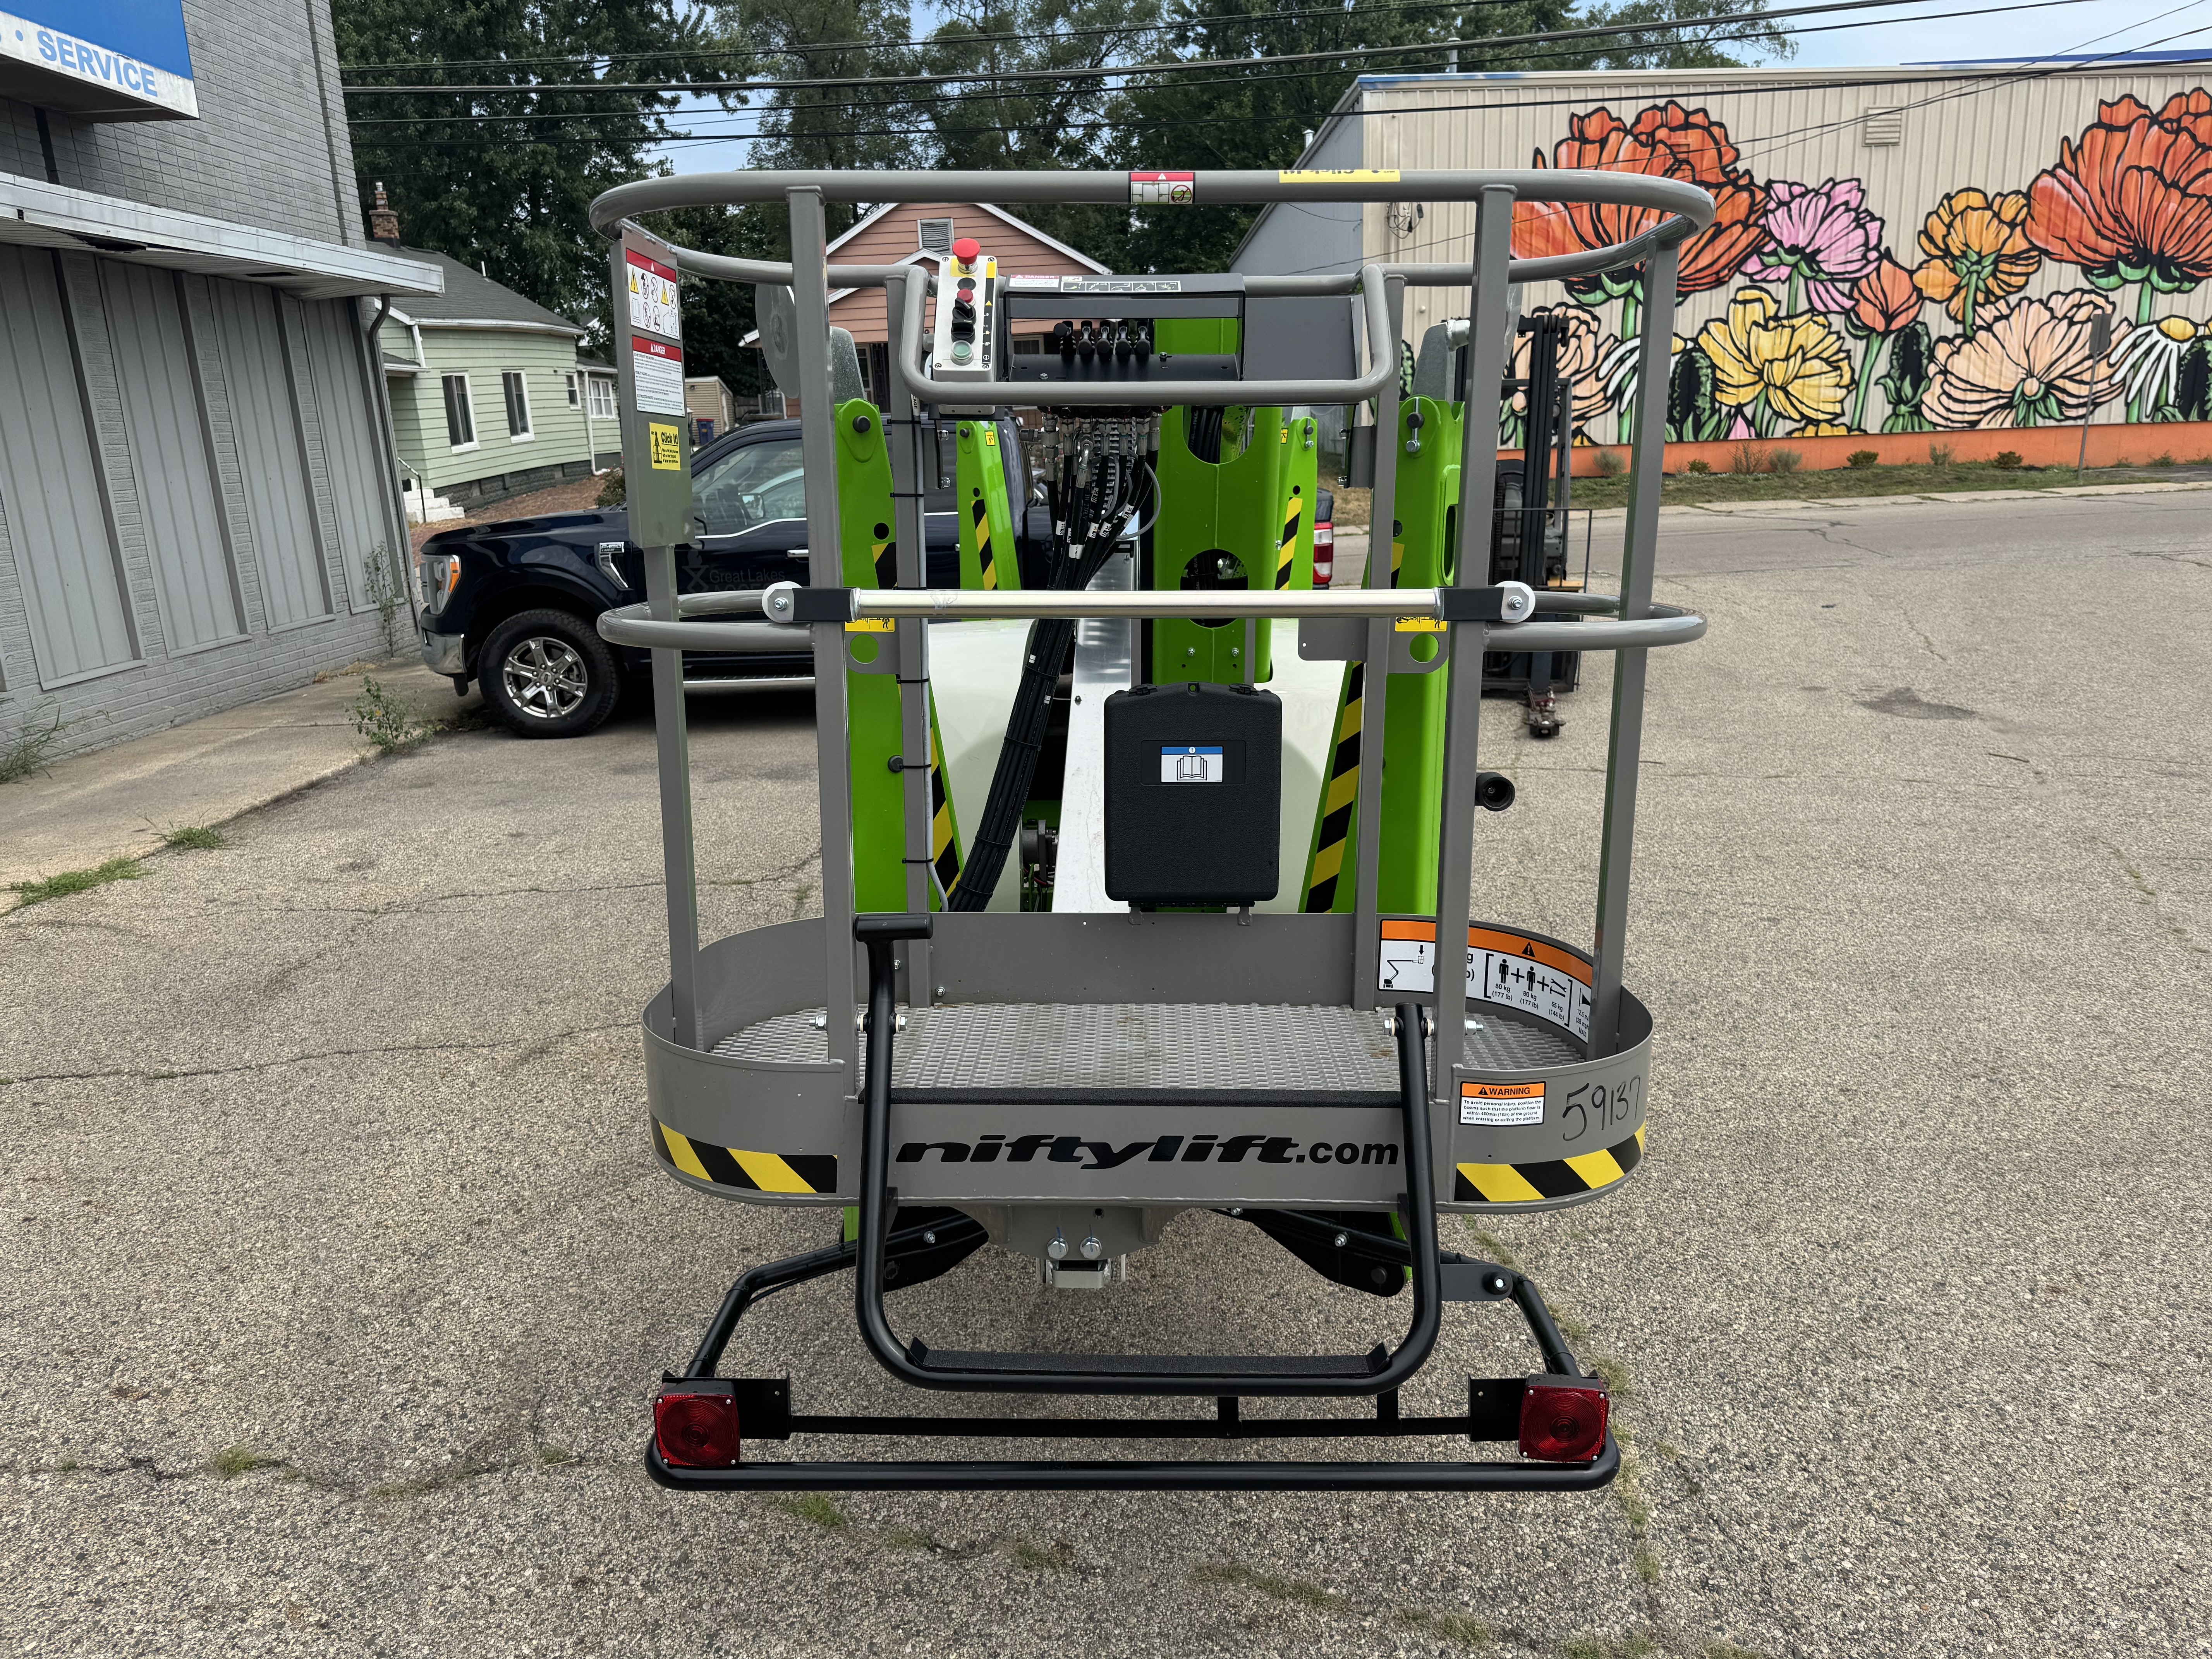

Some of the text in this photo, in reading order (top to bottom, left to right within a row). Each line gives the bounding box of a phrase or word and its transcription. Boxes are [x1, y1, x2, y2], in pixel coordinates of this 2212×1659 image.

[37, 31, 158, 97] SERVICE
[661, 432, 673, 444] Click
[710, 568, 785, 583] Great Lakes
[1530, 993, 1537, 1001] kg
[1549, 1009, 1558, 1017] (144
[1558, 1004, 1563, 1013] kg
[1489, 1087, 1530, 1096] WARNING
[1563, 1075, 1640, 1141] 59137
[895, 1134, 1399, 1170] niftylift.com
